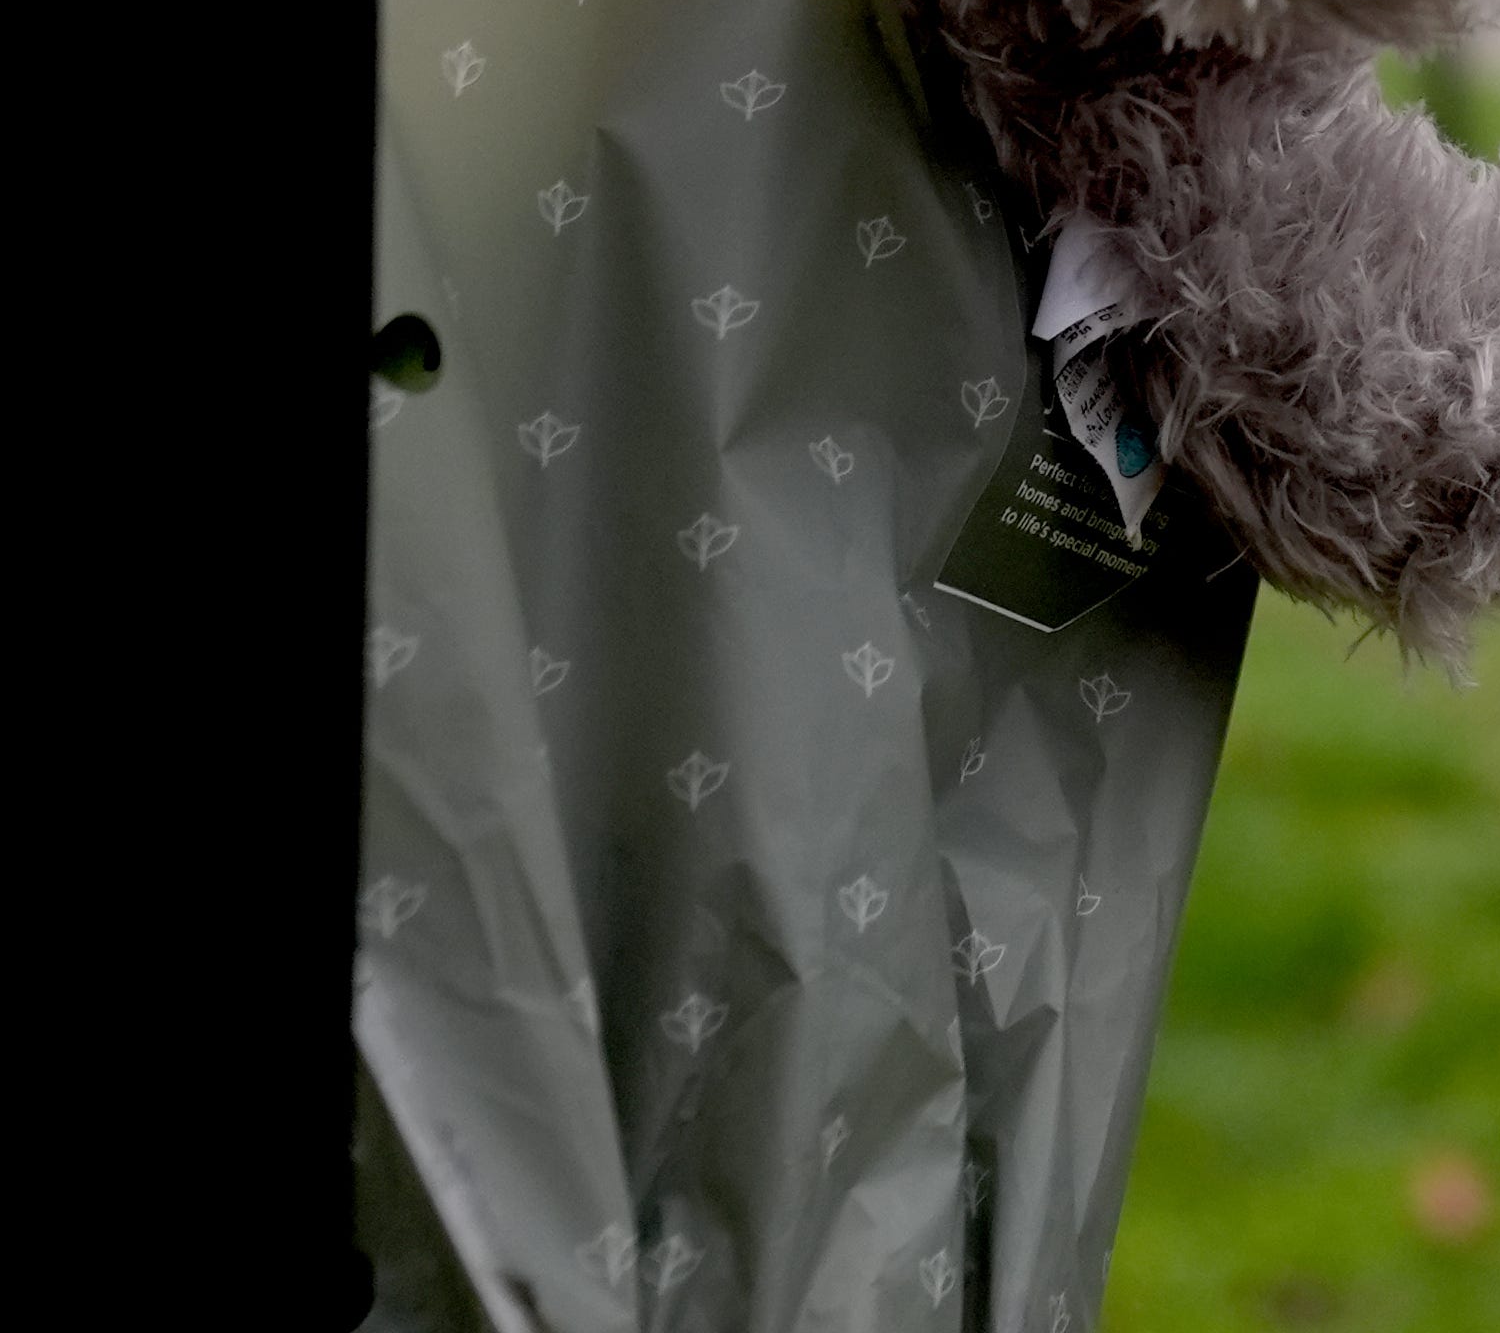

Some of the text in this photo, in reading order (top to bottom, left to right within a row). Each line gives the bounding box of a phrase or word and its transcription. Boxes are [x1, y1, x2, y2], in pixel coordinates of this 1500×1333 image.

[1029, 453, 1076, 488] Perfect
[1015, 478, 1062, 512] homes
[1060, 501, 1088, 523] and
[1000, 505, 1017, 526] to
[1016, 510, 1052, 539] life's
[1049, 528, 1098, 559] special
